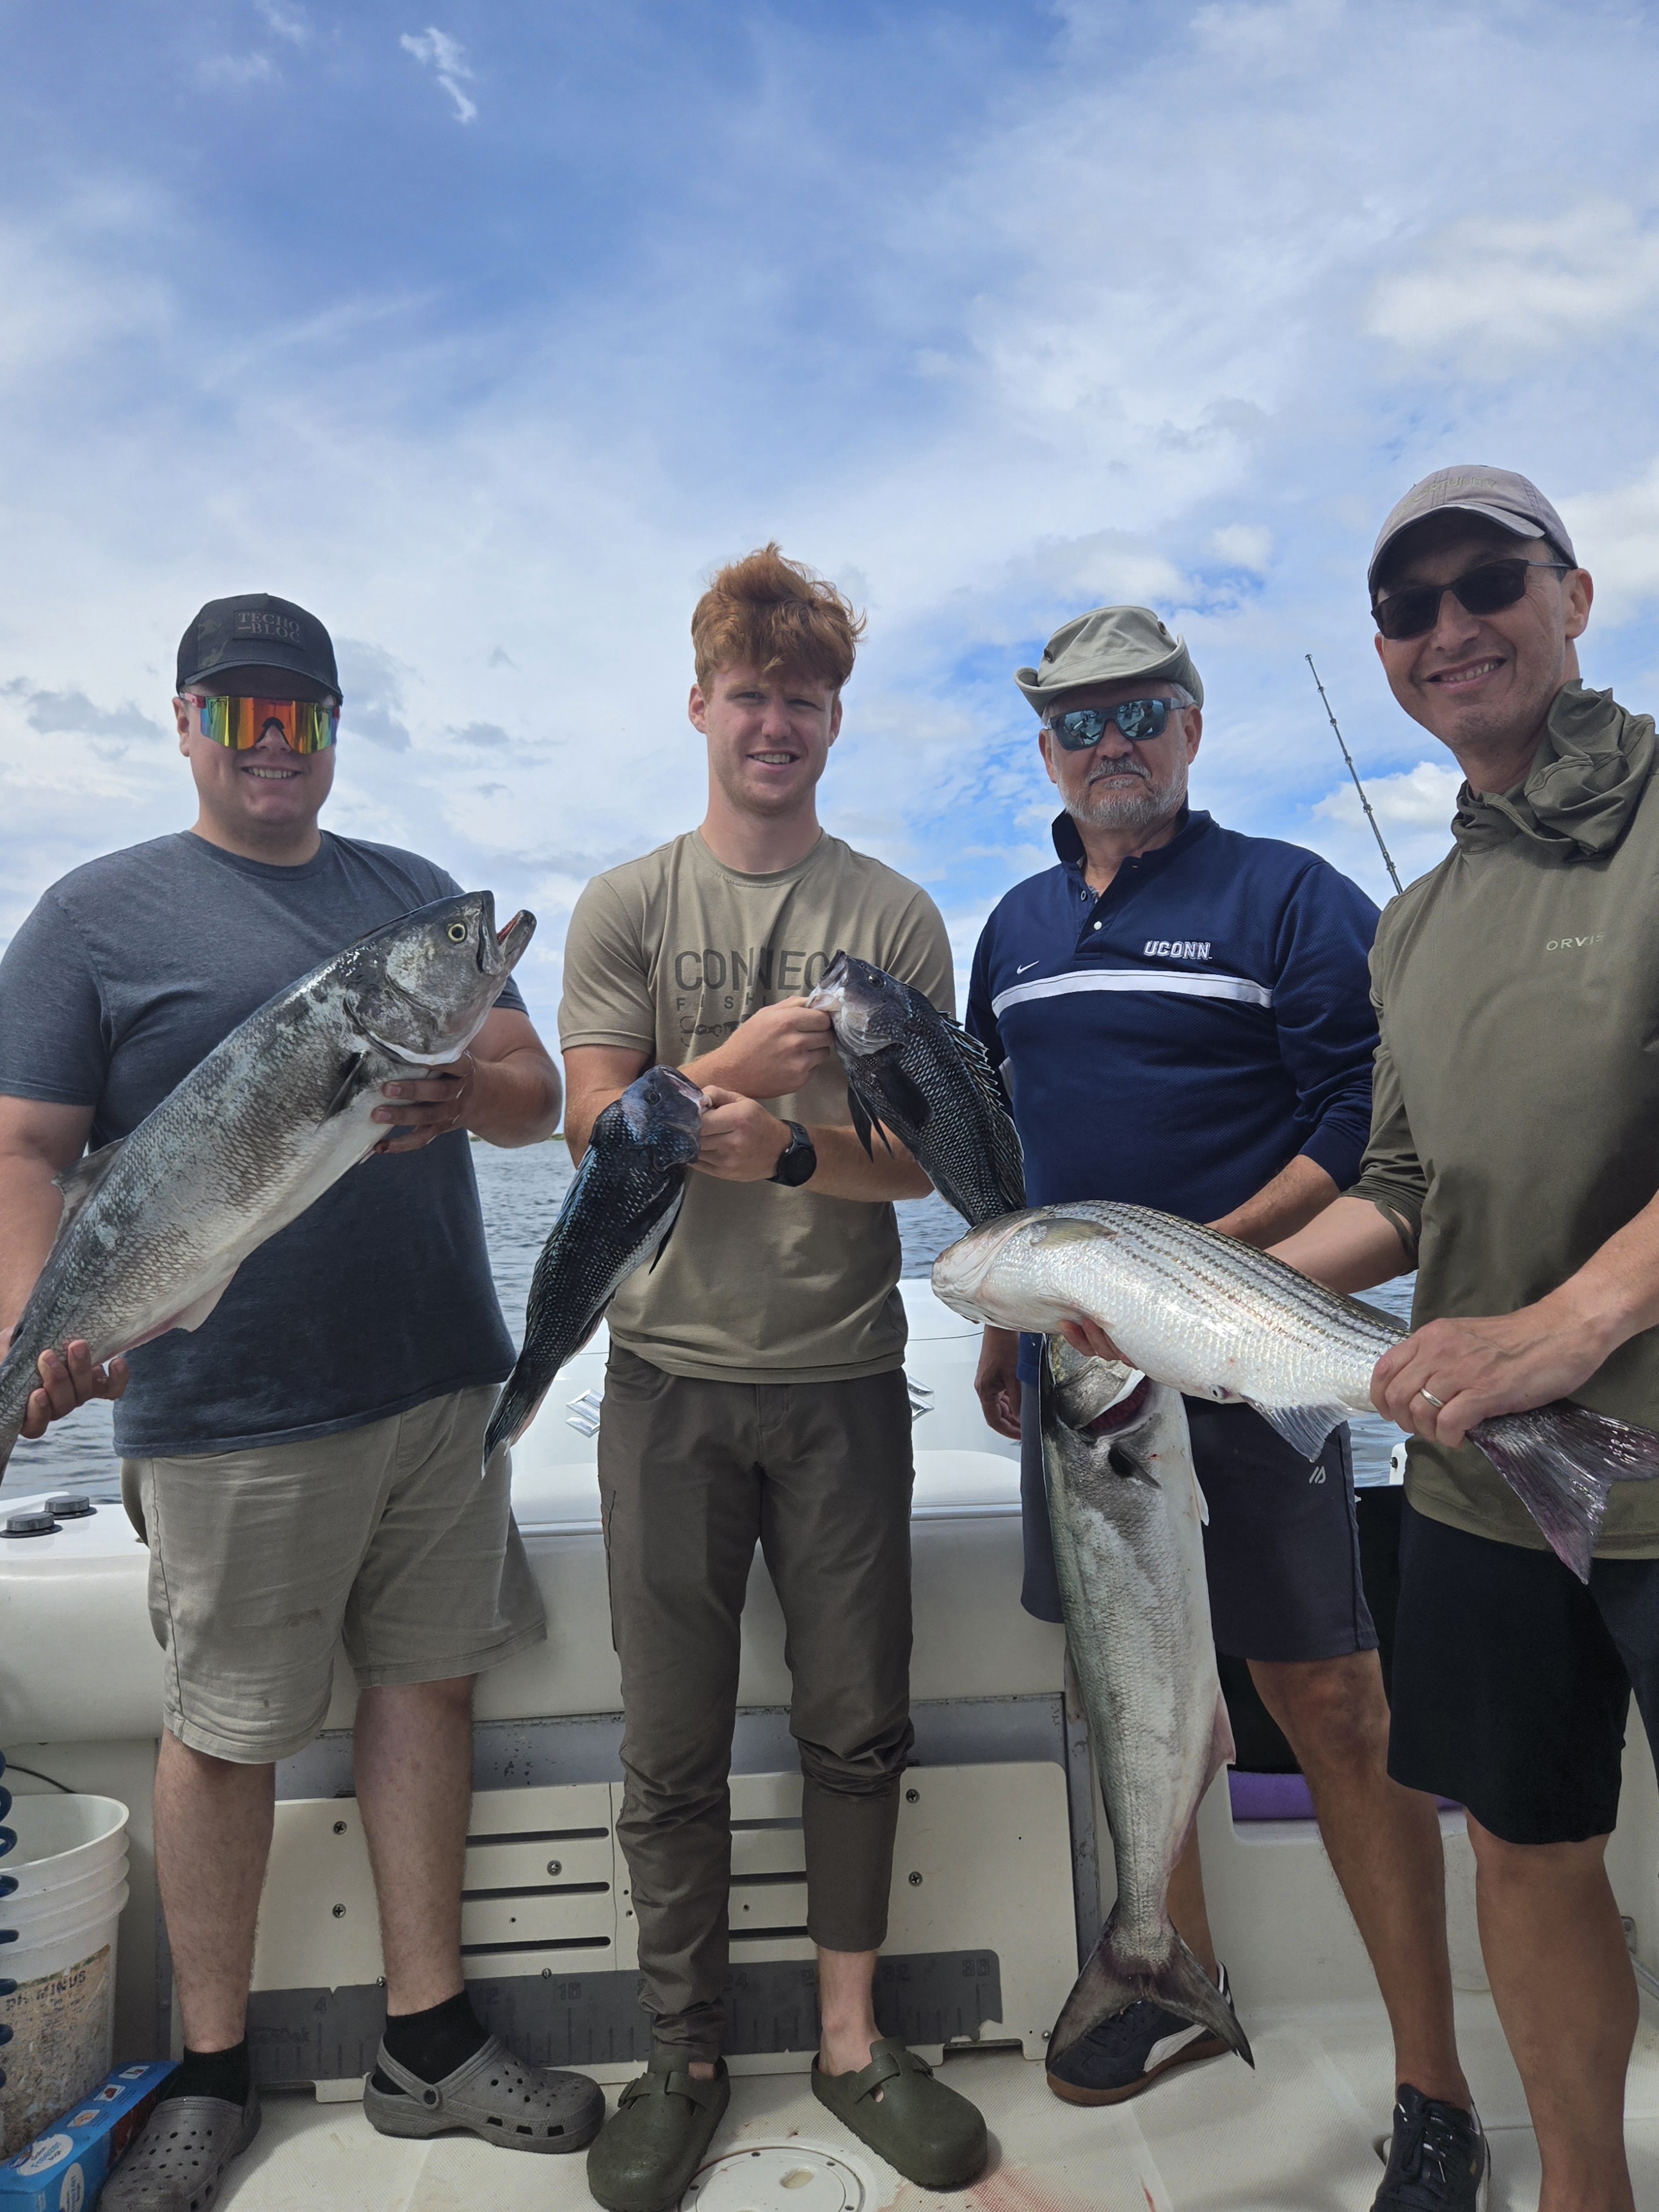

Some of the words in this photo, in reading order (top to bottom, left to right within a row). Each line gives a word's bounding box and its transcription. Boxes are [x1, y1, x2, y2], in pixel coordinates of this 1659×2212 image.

[237, 613, 300, 632] TECHO
[1143, 940, 1212, 960] UCONN
[1546, 931, 1606, 951] ORVIS
[676, 991, 790, 1012] FISHI
[801, 1969, 815, 1987] 2
